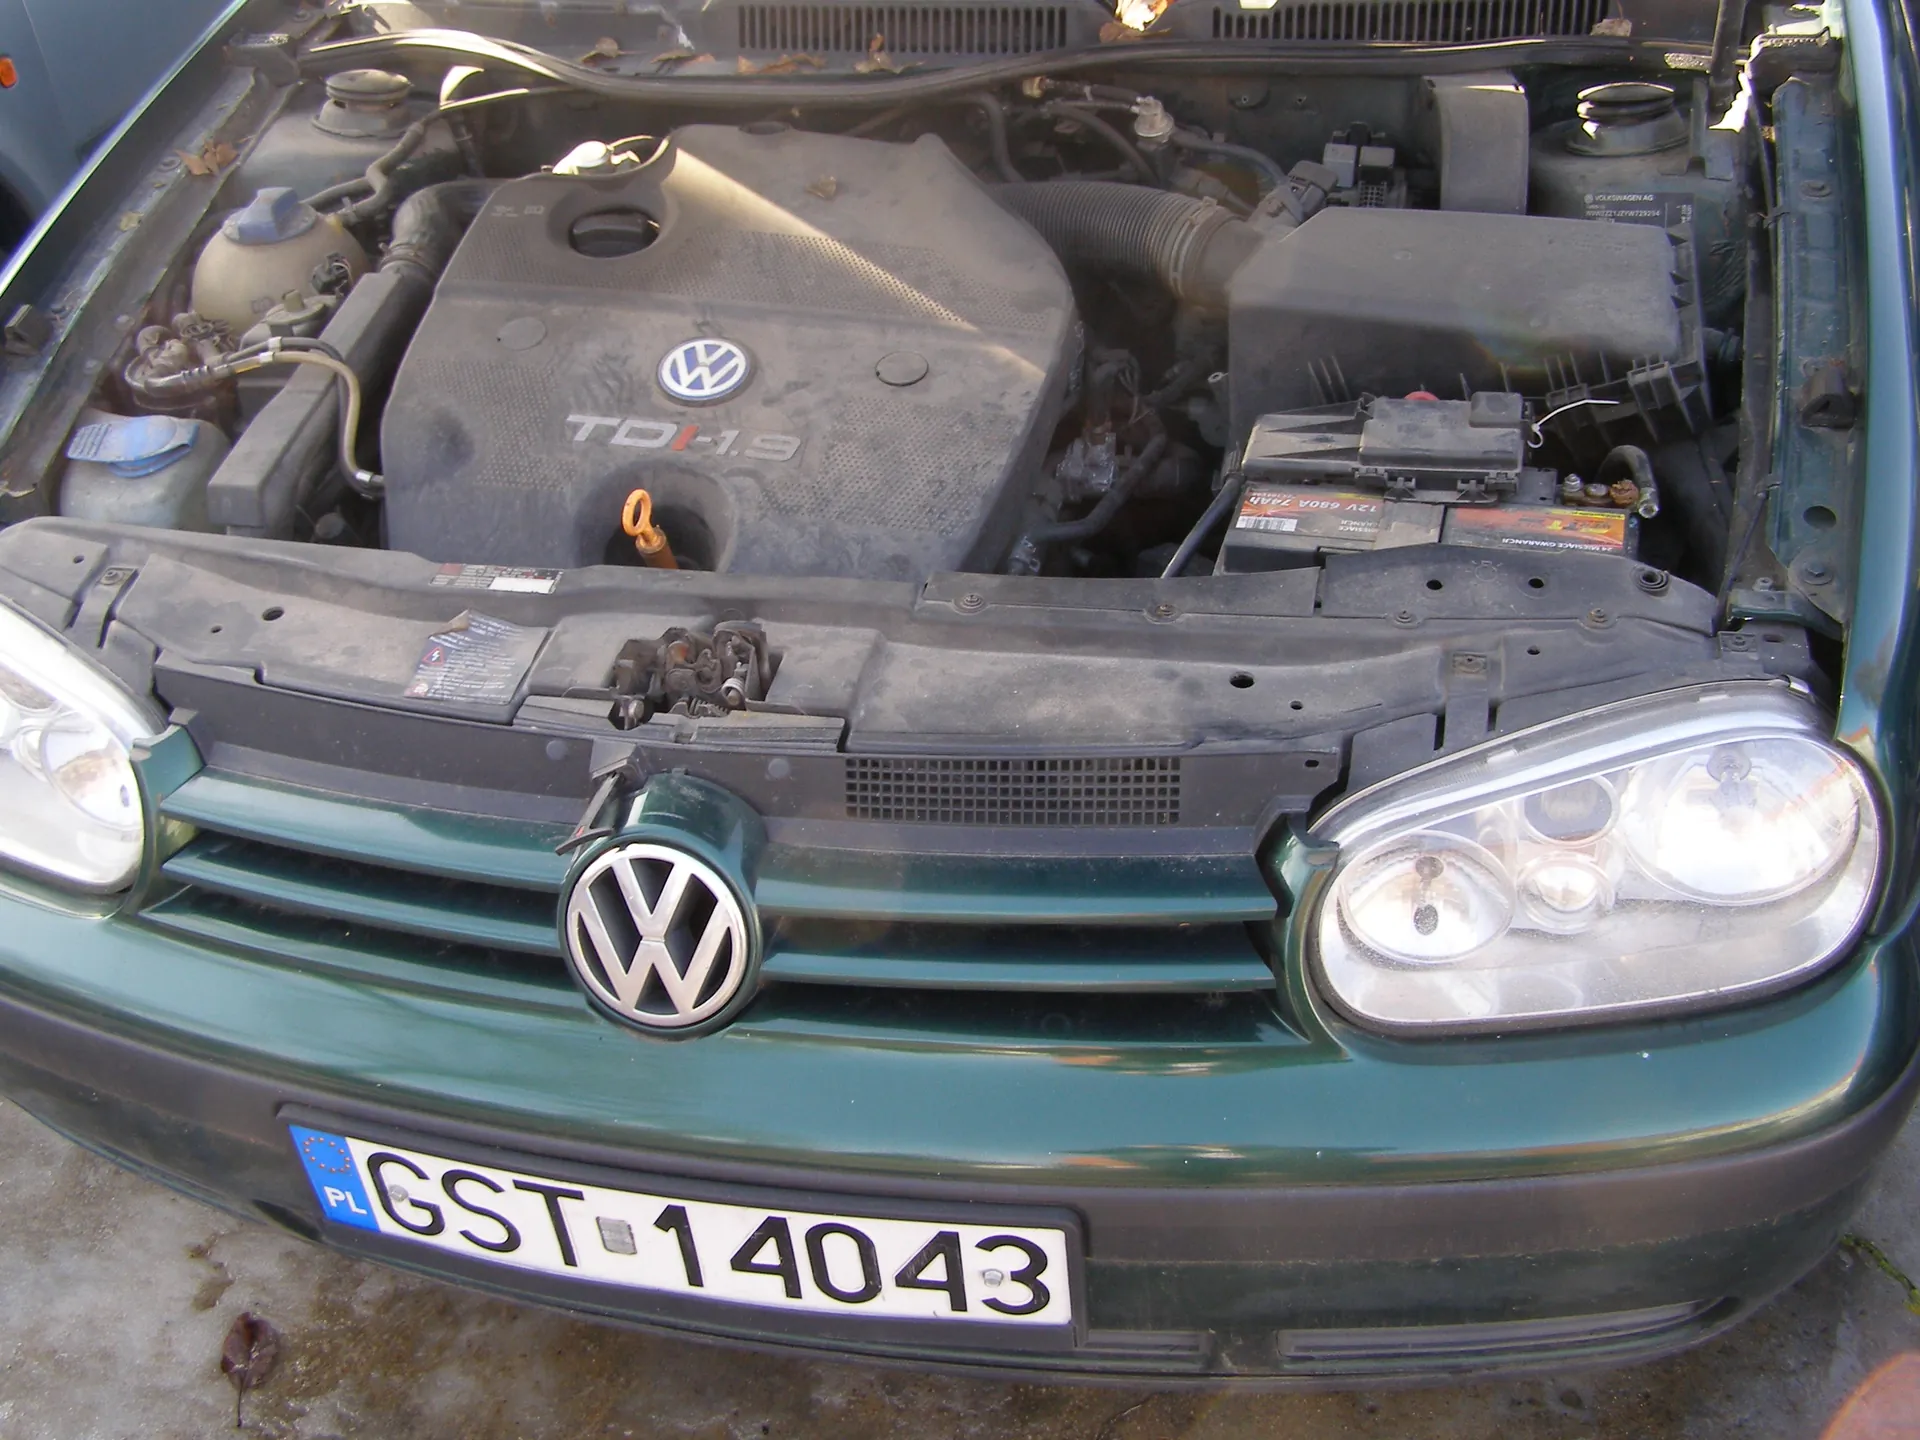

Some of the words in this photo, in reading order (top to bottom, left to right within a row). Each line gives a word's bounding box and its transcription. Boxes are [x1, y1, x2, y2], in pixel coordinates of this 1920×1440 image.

[1595, 194, 1643, 202] VOLKSWAGEN
[1643, 194, 1654, 202] AG
[1250, 497, 1291, 506] 74Ah
[1299, 500, 1341, 509] 680A
[1346, 504, 1377, 512] 12V
[1502, 538, 1556, 548] GWARANCJI
[324, 1186, 367, 1214] PL
[367, 1152, 585, 1267] GST
[653, 1204, 1050, 1315] 14043
